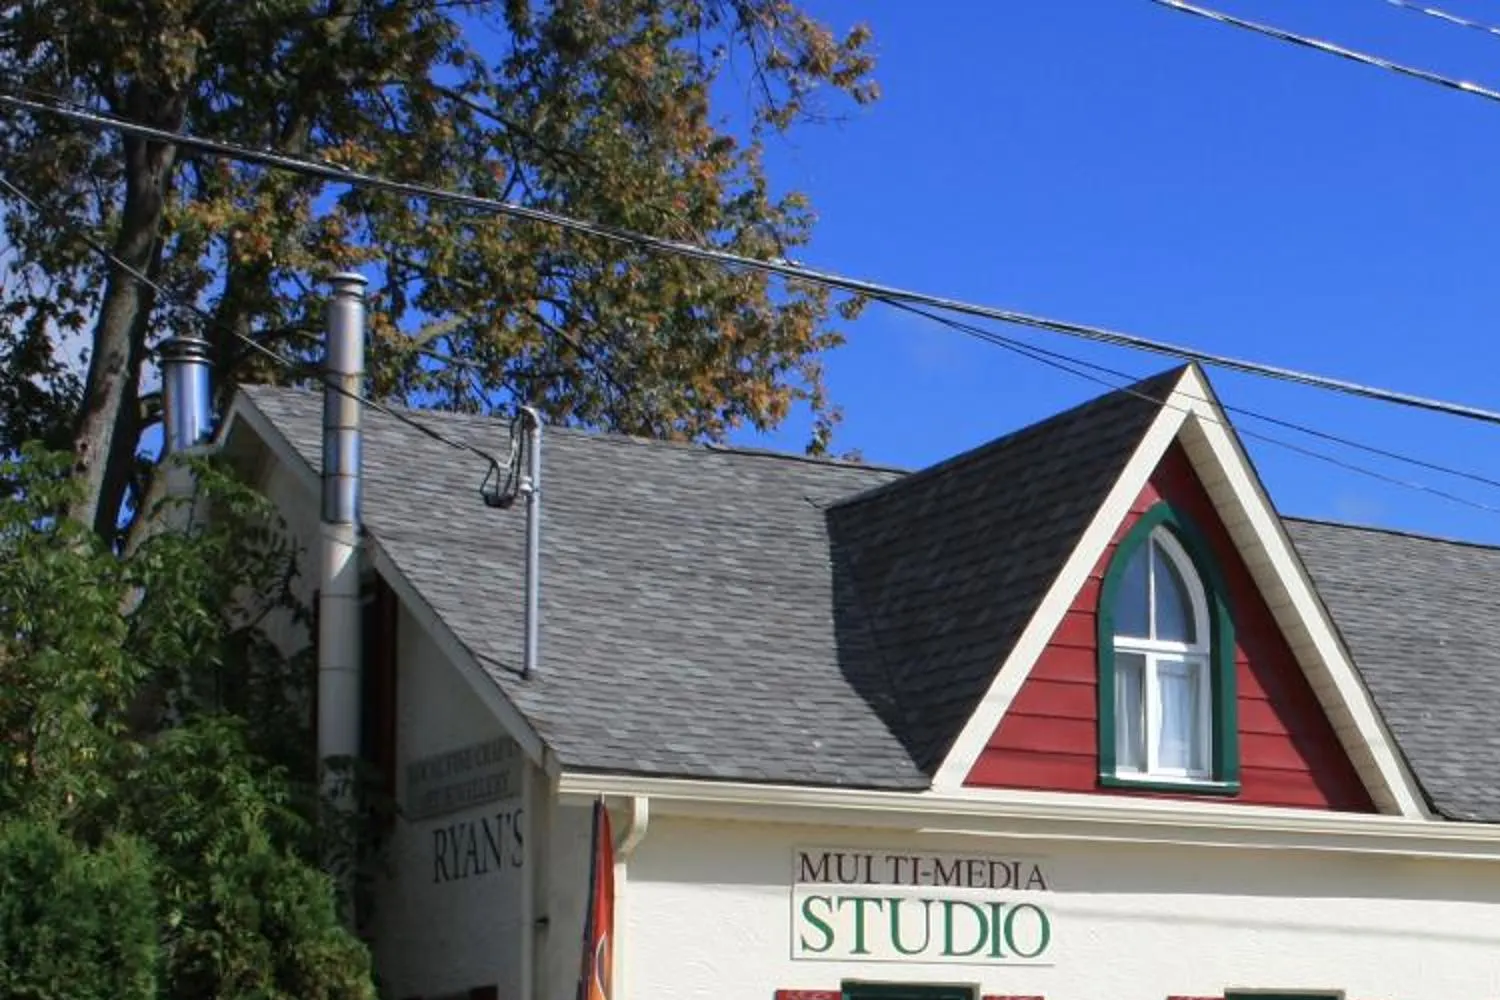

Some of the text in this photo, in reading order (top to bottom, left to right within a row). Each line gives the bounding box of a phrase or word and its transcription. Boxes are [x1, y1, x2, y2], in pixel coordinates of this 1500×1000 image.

[433, 808, 523, 883] RYAN'S
[800, 851, 1048, 891] MULTI-MEDIA
[800, 895, 1051, 958] STUDIO
